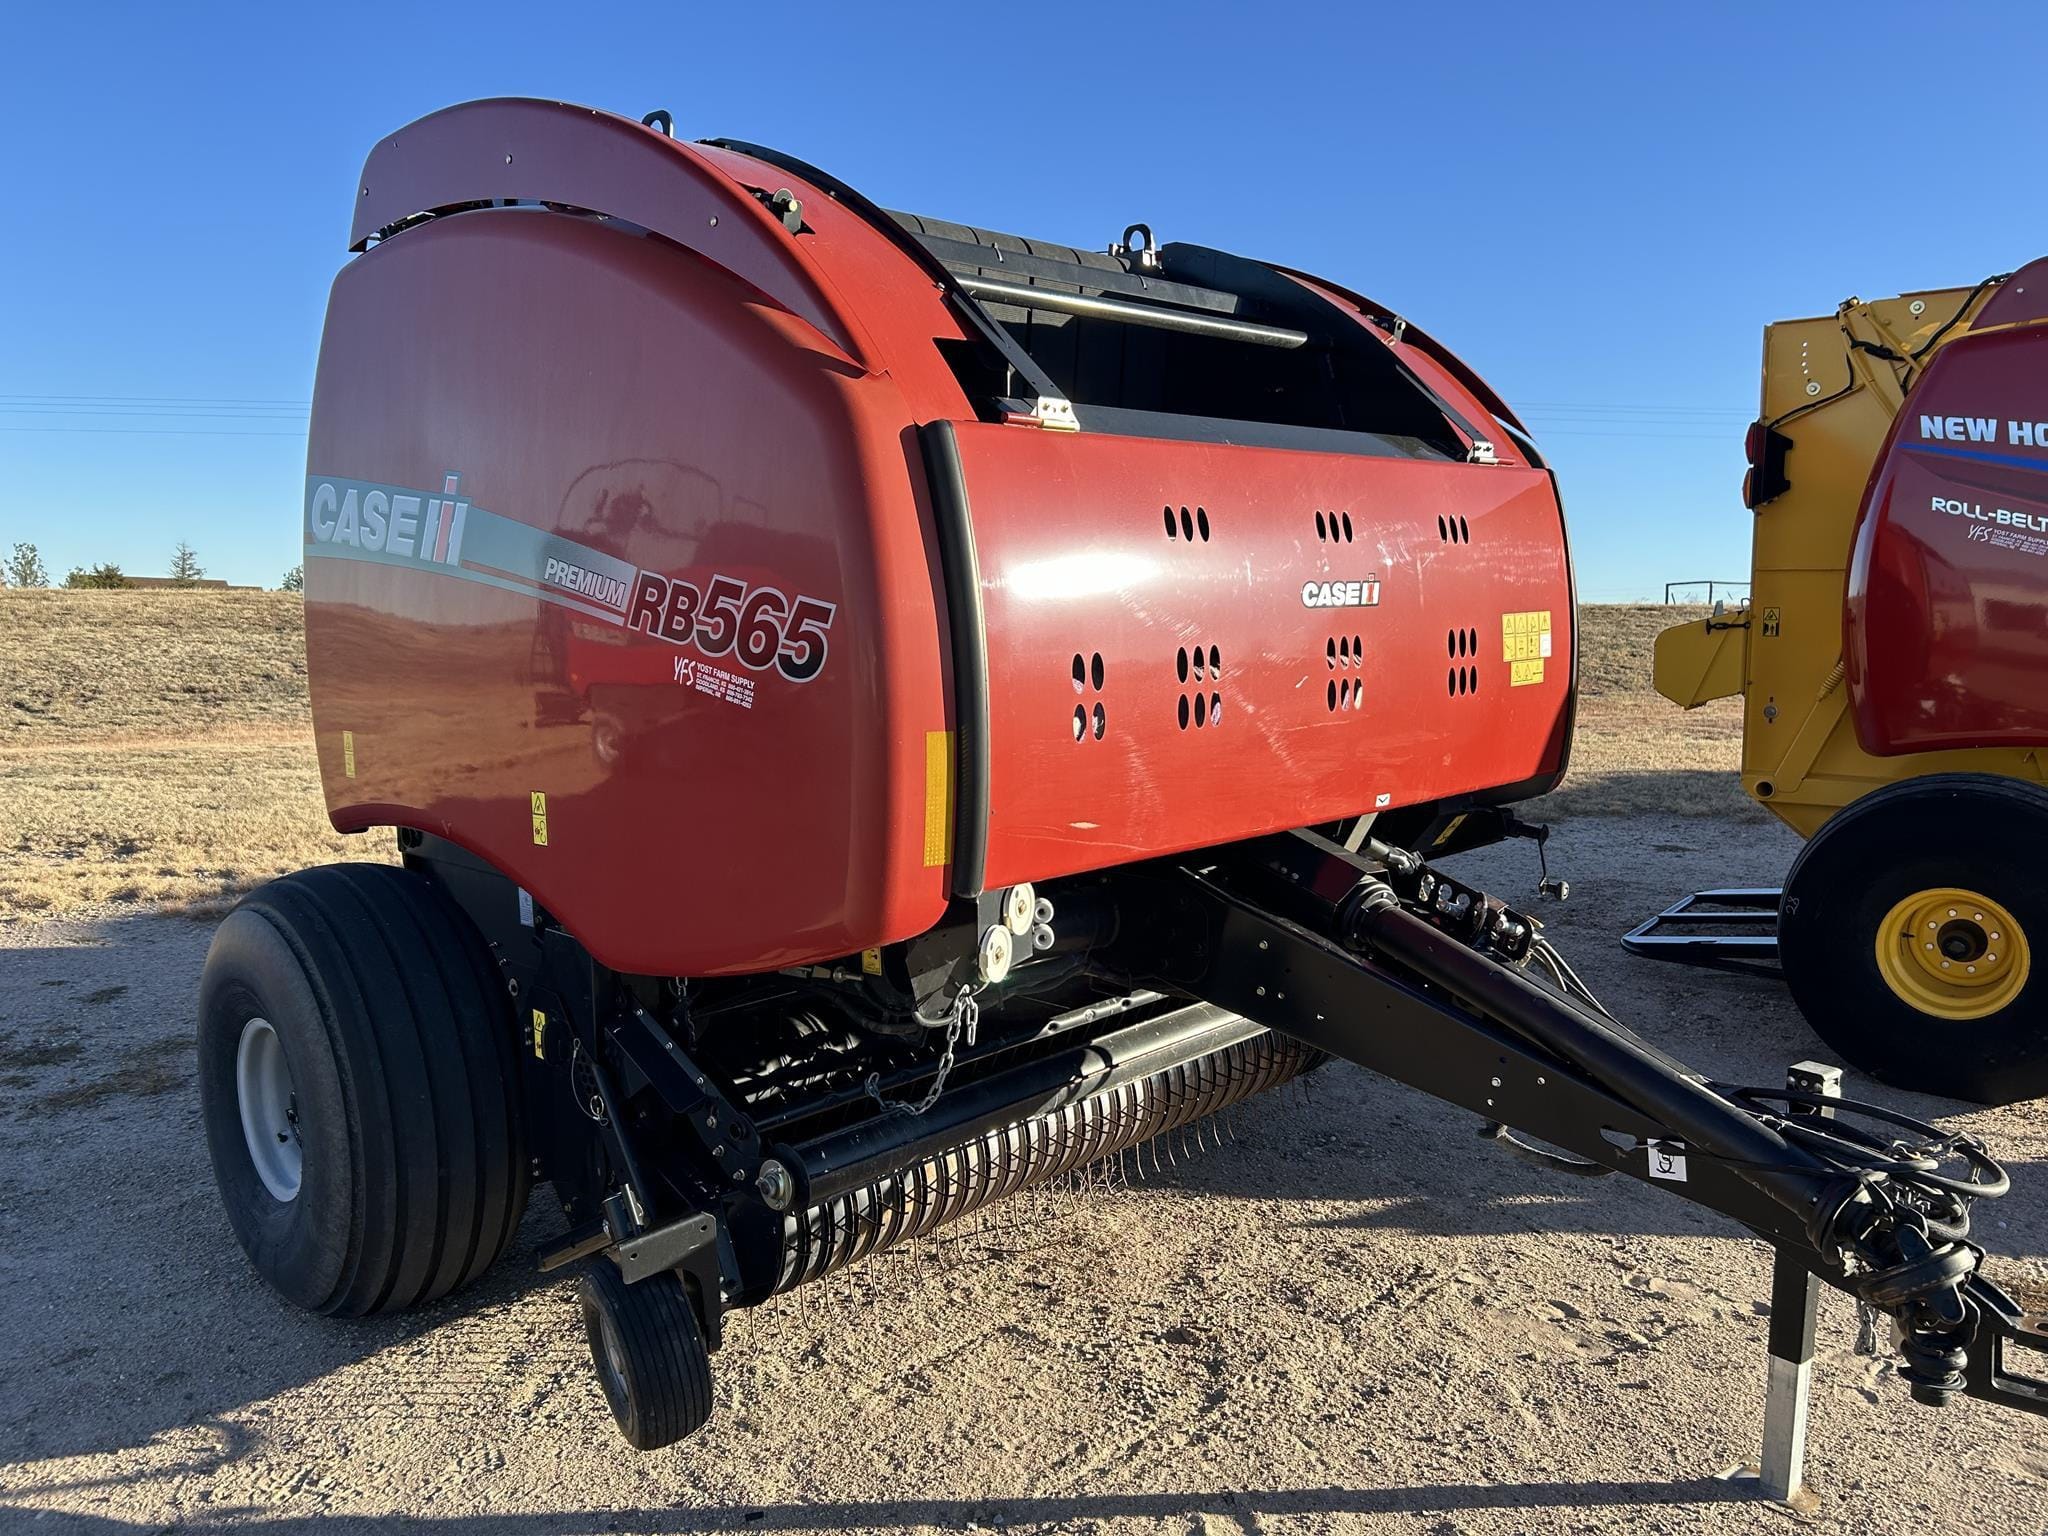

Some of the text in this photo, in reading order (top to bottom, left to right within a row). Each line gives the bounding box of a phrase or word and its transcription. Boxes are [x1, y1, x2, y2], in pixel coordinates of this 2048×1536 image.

[1919, 415, 1997, 443] NEW
[1931, 497, 2048, 533] ROLL-BELT
[1967, 524, 1993, 542] YFS
[2009, 532, 2027, 541] FARM
[544, 558, 626, 608] PREMIUM
[628, 570, 837, 683] RB565
[674, 655, 696, 686] YFS
[696, 662, 755, 689] YOST FARM SUPPLY
